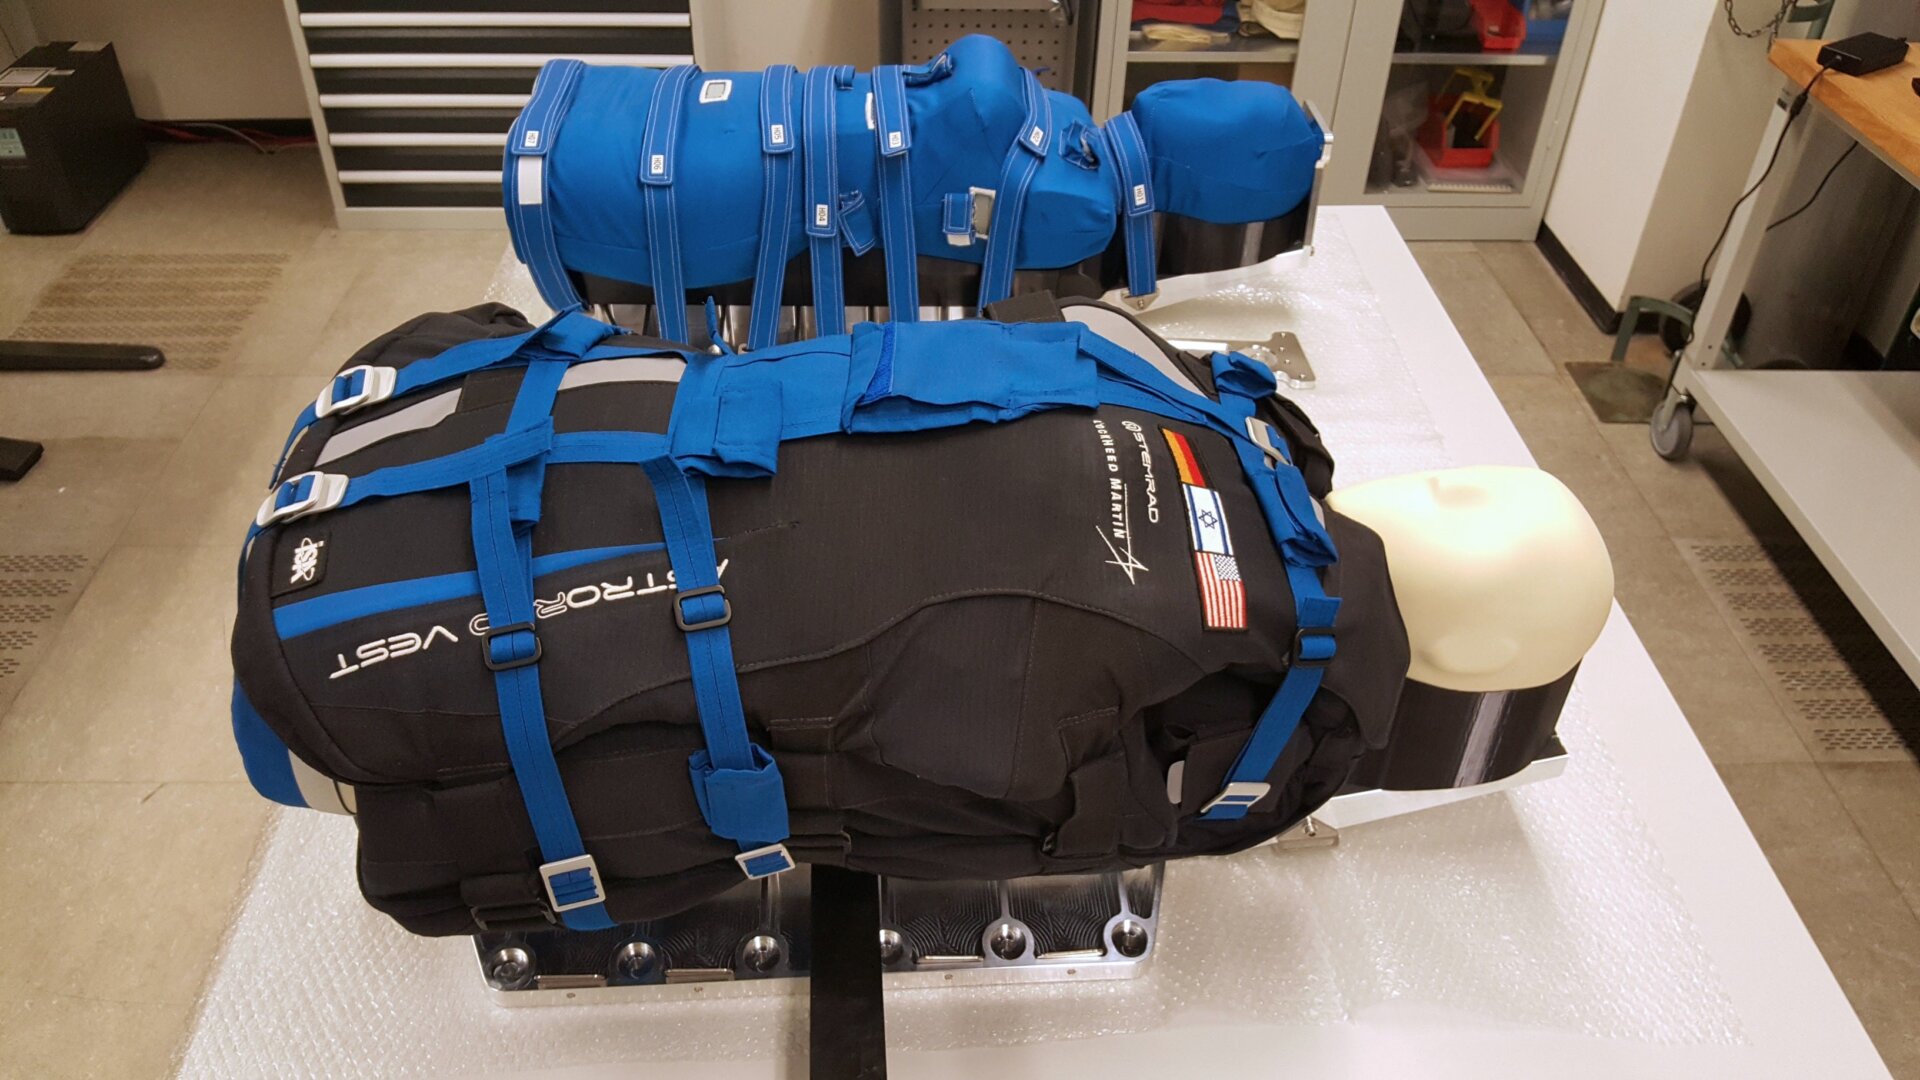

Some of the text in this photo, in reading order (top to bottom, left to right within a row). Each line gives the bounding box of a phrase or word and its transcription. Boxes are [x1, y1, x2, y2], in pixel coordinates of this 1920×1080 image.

[653, 157, 662, 170] H06
[818, 207, 827, 221] H04
[1093, 420, 1127, 539] LOCKHEED MARTIN
[1133, 432, 1159, 523] STEMRAD
[329, 625, 459, 679] VEST
